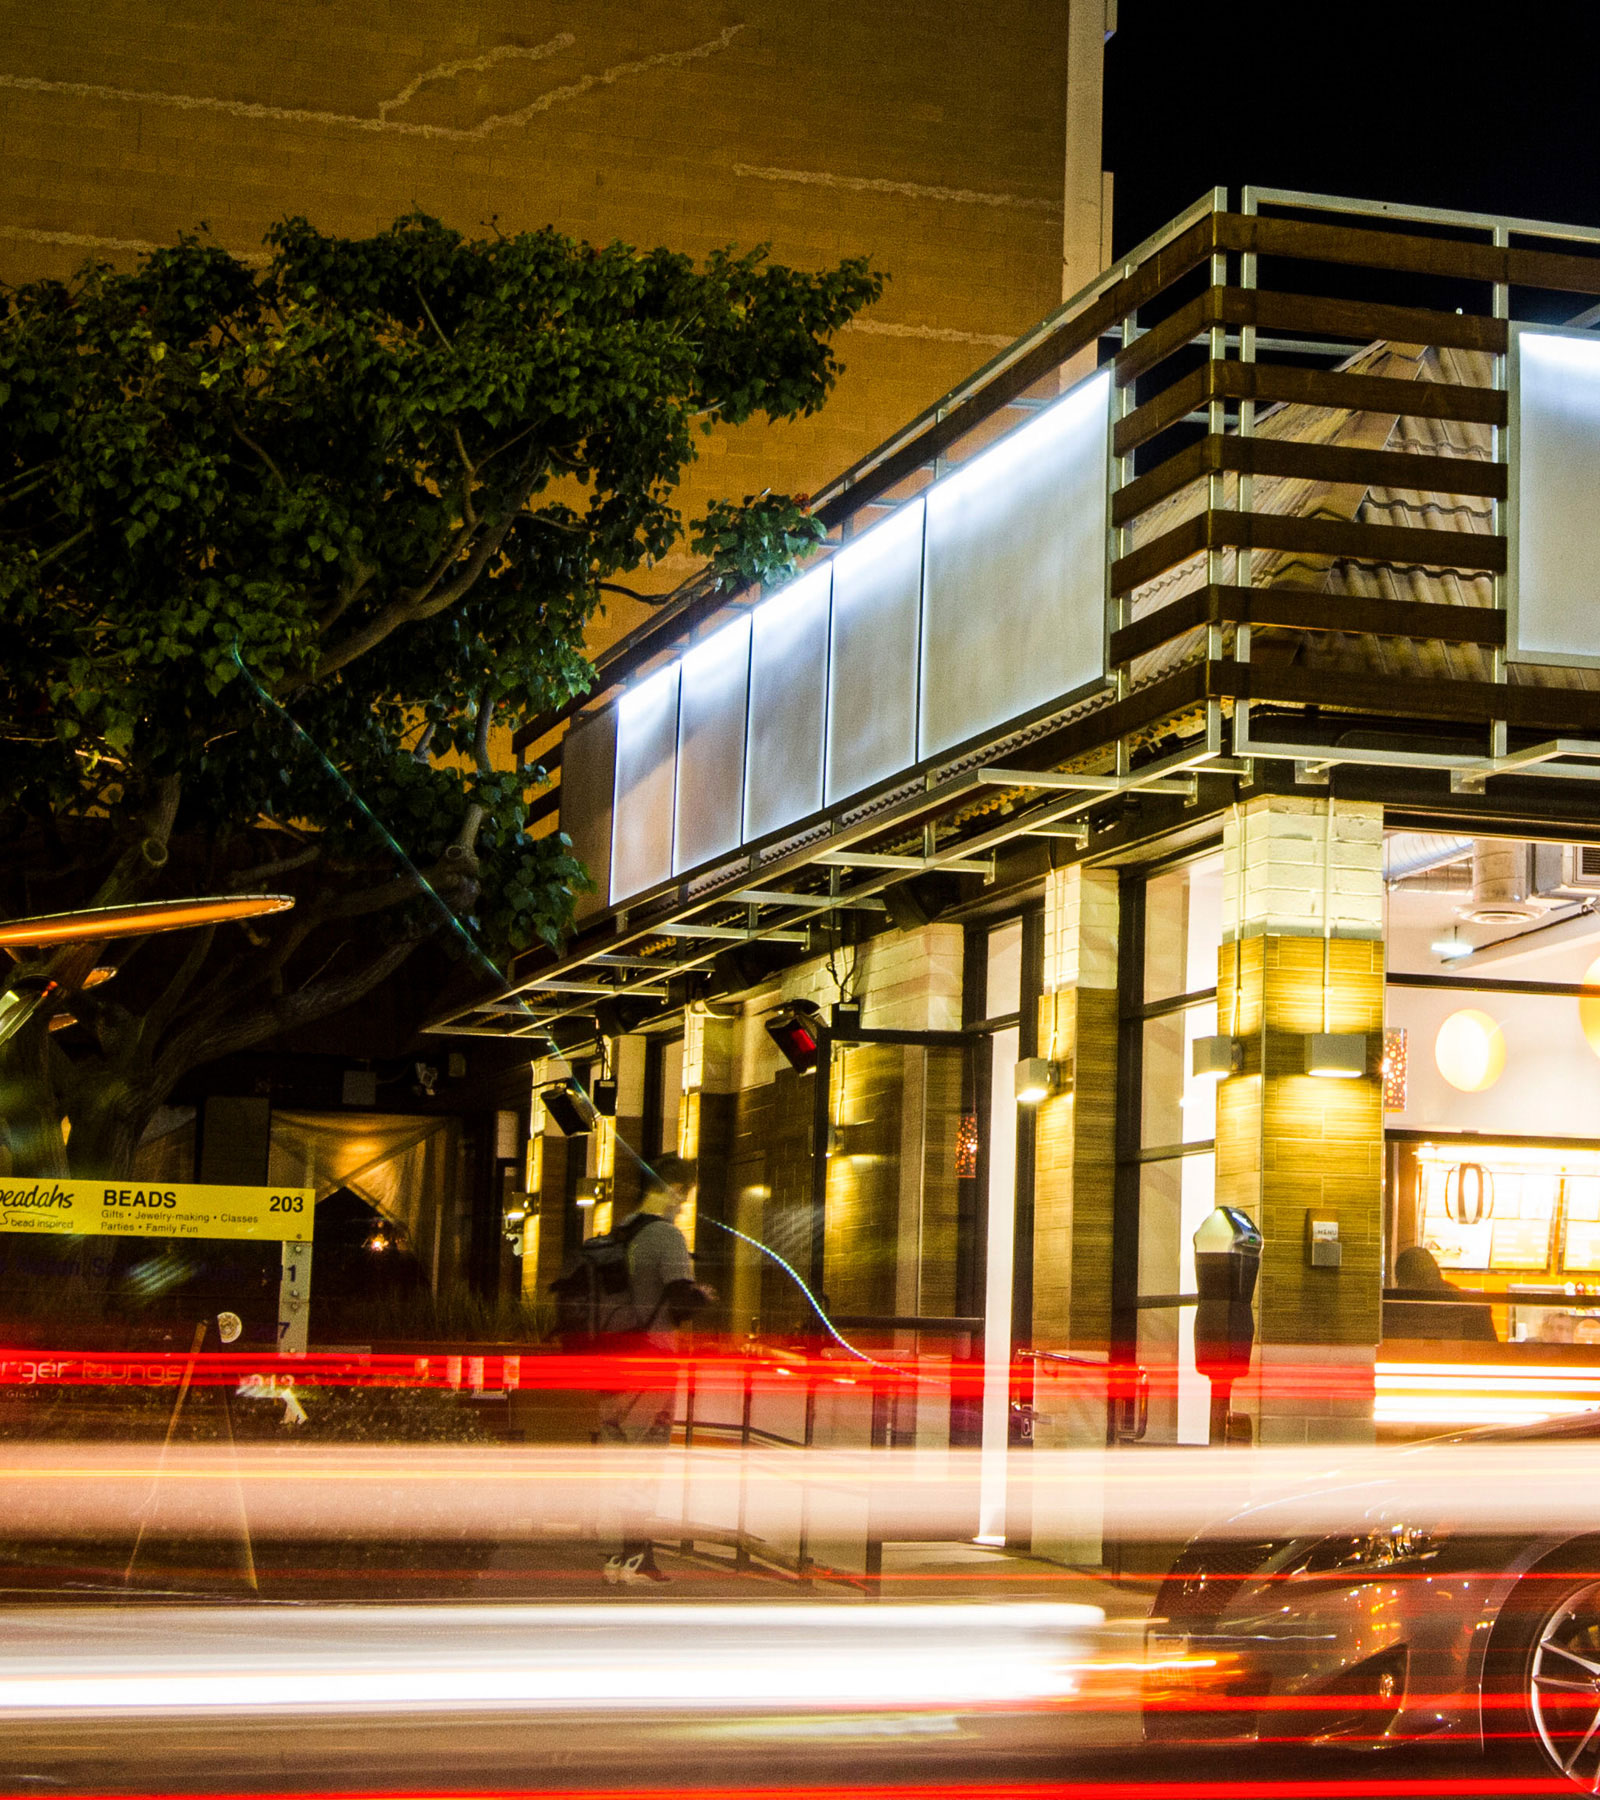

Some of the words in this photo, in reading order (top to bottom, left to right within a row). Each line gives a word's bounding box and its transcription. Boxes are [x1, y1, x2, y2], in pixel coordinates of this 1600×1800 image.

[103, 1190, 177, 1208] BEADS
[269, 1196, 304, 1213] 203
[101, 1210, 125, 1219] Gifts
[135, 1211, 210, 1223] Jewelry-making
[220, 1213, 259, 1223] Classes
[11, 1219, 35, 1228] bead
[37, 1220, 74, 1230] inspired
[101, 1222, 135, 1231] Parties
[146, 1223, 177, 1234] Family
[180, 1224, 199, 1233] Fun
